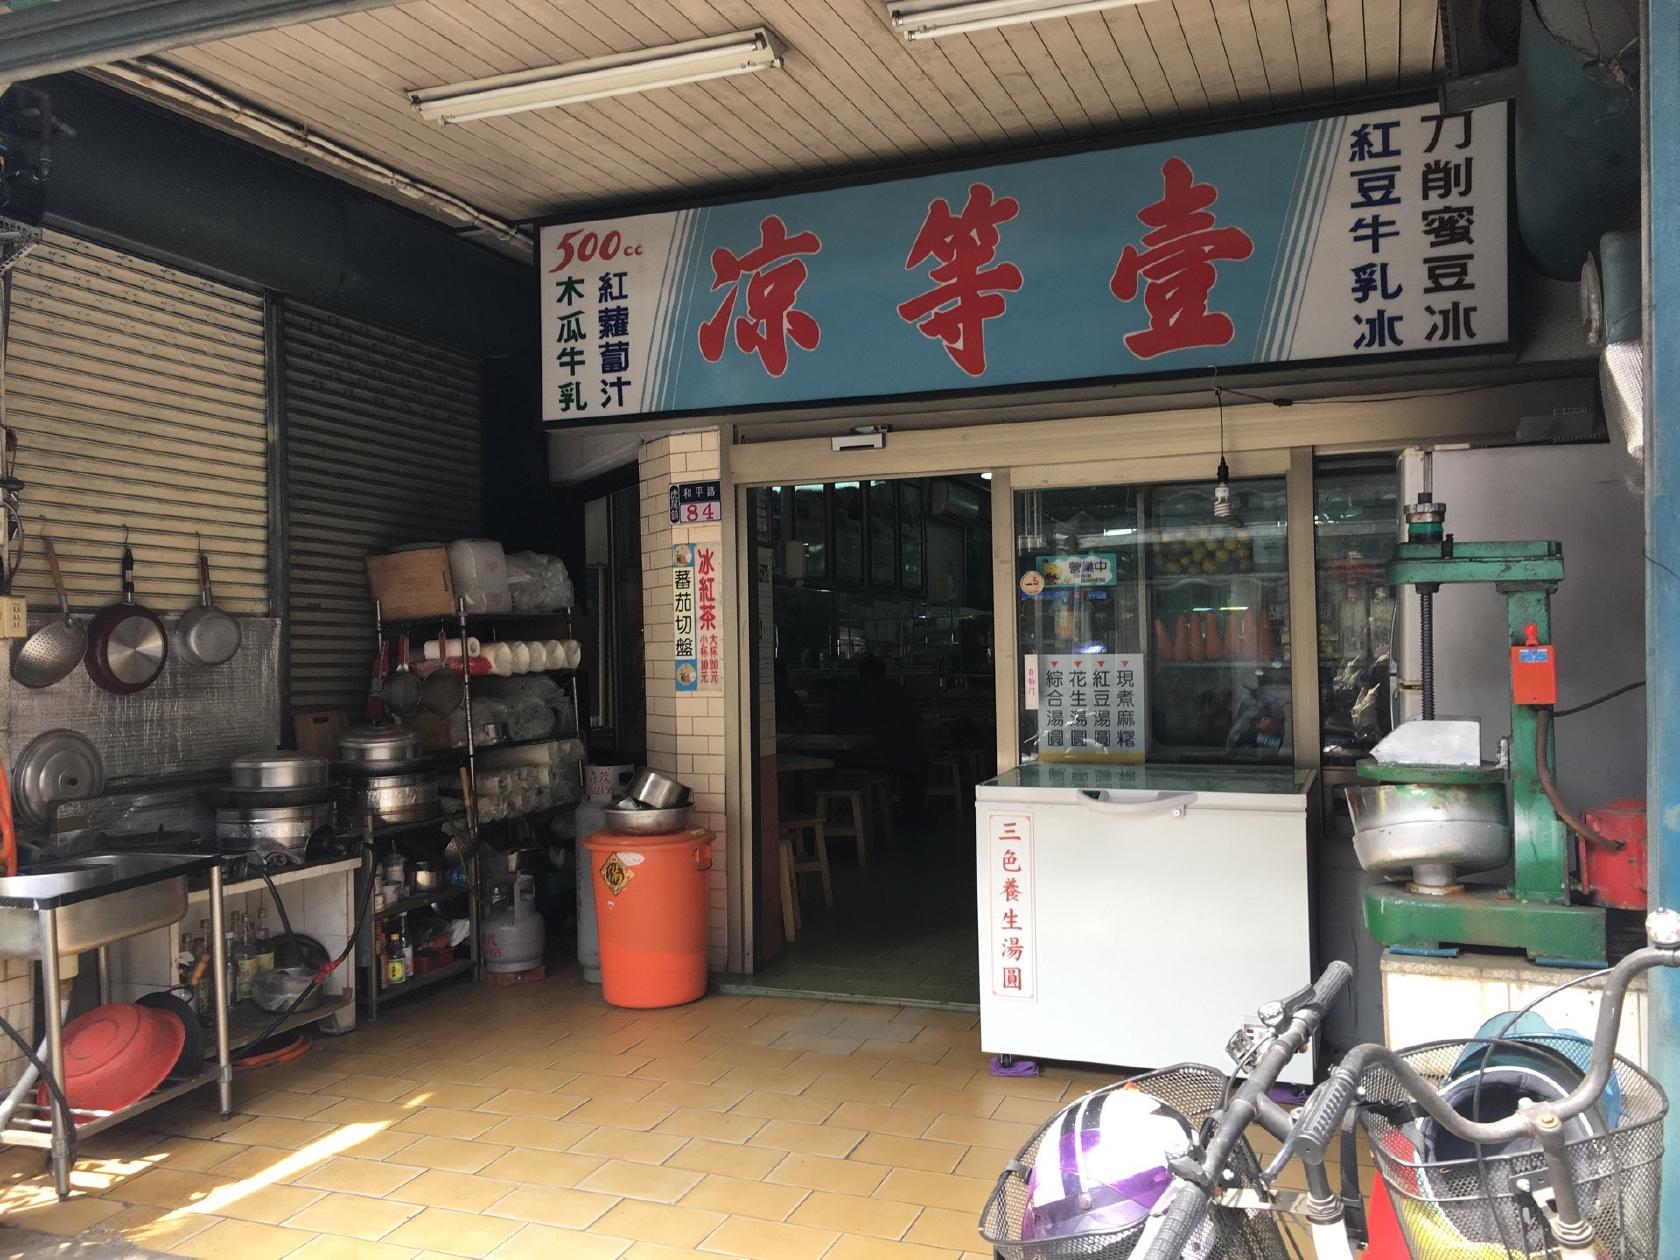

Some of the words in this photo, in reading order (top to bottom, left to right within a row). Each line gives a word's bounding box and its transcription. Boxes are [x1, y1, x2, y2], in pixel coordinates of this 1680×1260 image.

[1348, 120, 1403, 348] 紅豆牛乳冰
[1420, 110, 1477, 342] 刀削蜜豆冰
[556, 276, 588, 412] 木瓜牛乳
[598, 272, 631, 408] 紅蘿蔔汁
[682, 486, 716, 499] 和平路
[687, 502, 714, 521] 84
[698, 548, 716, 630] 冰紅茶
[1045, 670, 1064, 747] 綜合湯圓
[1069, 670, 1088, 747] 花生湯圓
[1092, 669, 1111, 747] 紅豆湯圓
[1116, 670, 1136, 748] 現煮麻糬
[998, 822, 1024, 991] 三色養生湯圓
